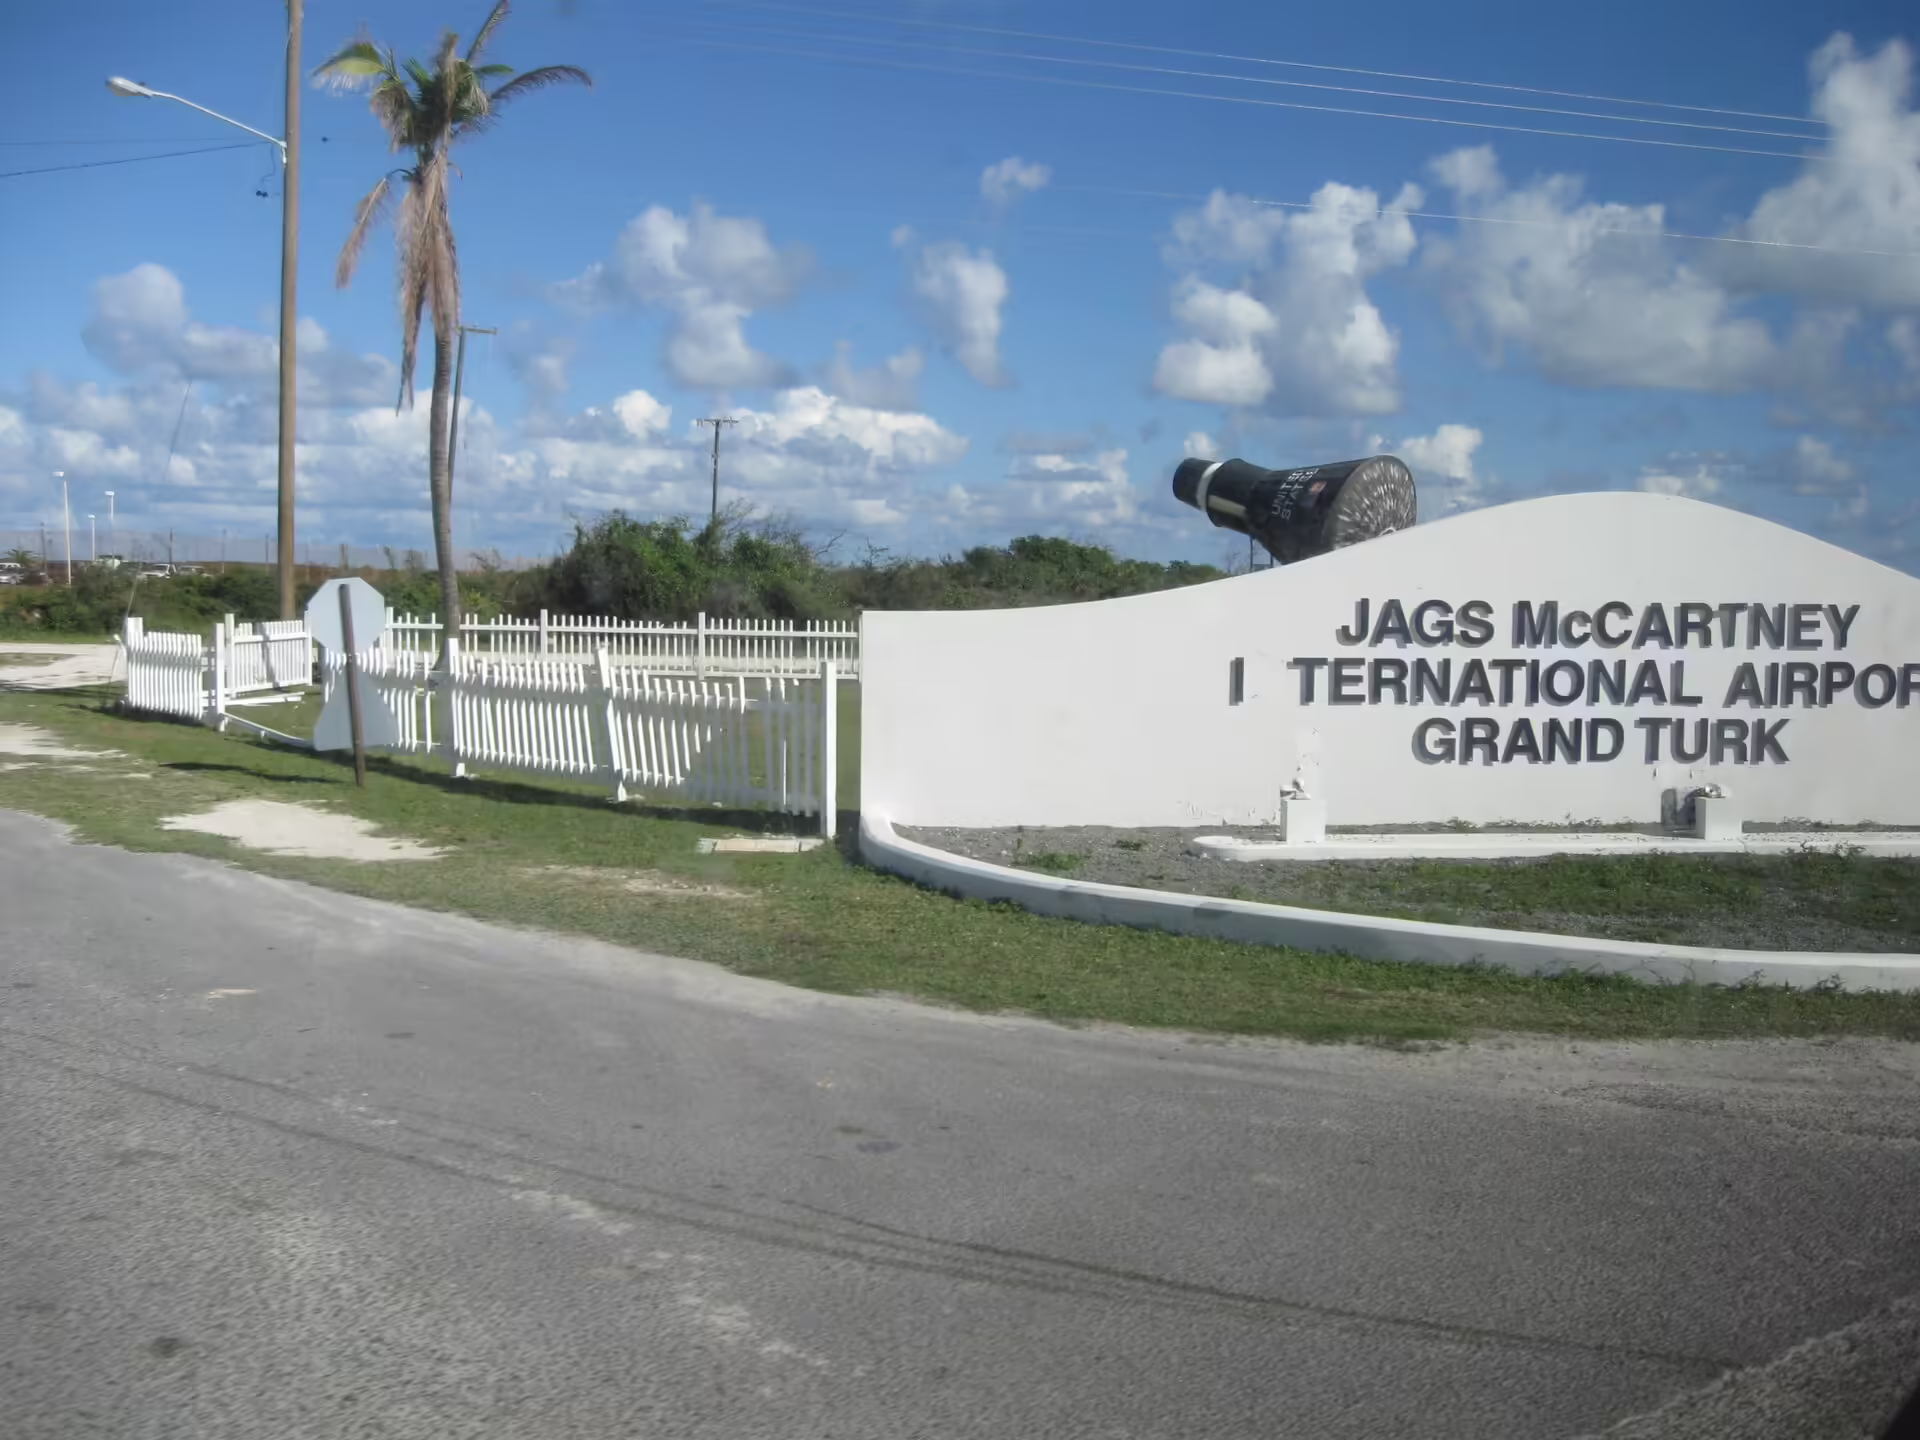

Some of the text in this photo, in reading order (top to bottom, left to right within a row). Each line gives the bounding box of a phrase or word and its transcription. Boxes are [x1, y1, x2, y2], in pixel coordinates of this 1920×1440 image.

[1336, 598, 1861, 651] JAGS McCARTNEY
[1411, 717, 1792, 766] GRAND TURK
